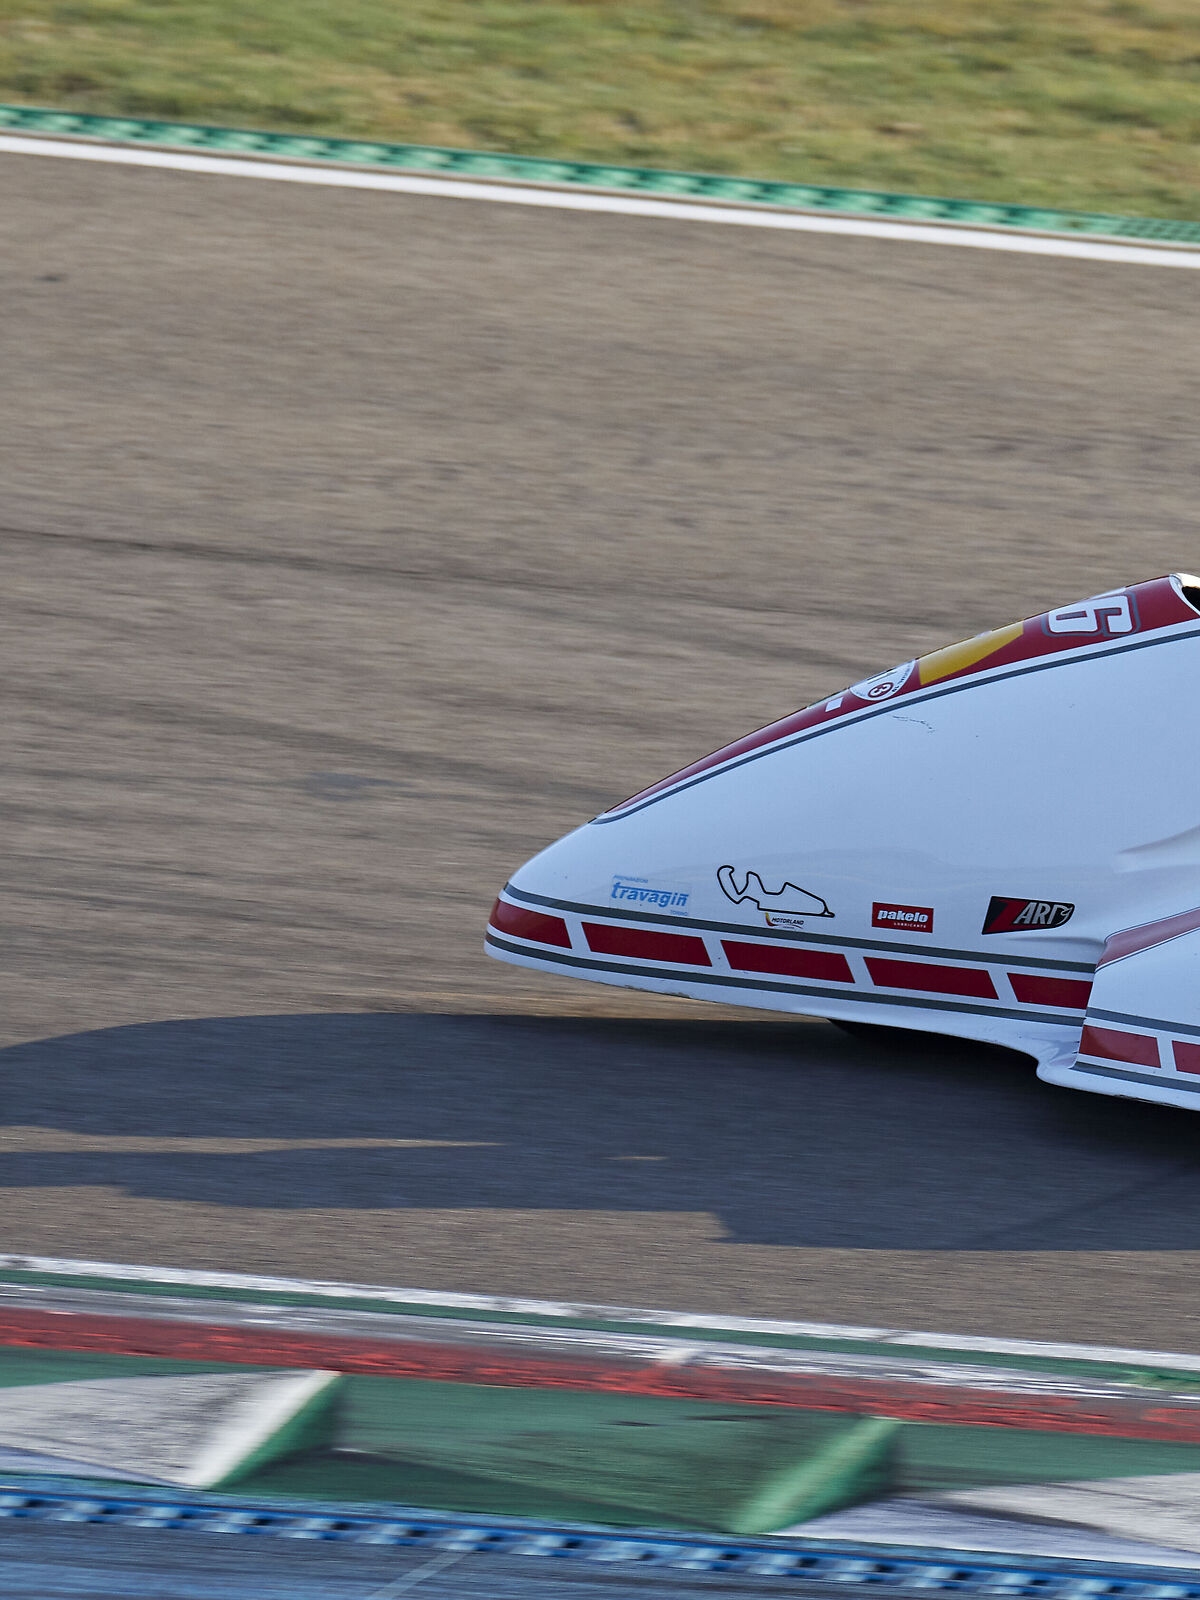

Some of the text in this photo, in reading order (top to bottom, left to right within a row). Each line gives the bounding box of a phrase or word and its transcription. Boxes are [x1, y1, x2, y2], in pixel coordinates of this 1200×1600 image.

[611, 882, 689, 907] travagin
[771, 917, 805, 925] MOTORLAND
[877, 910, 928, 923] pakelo
